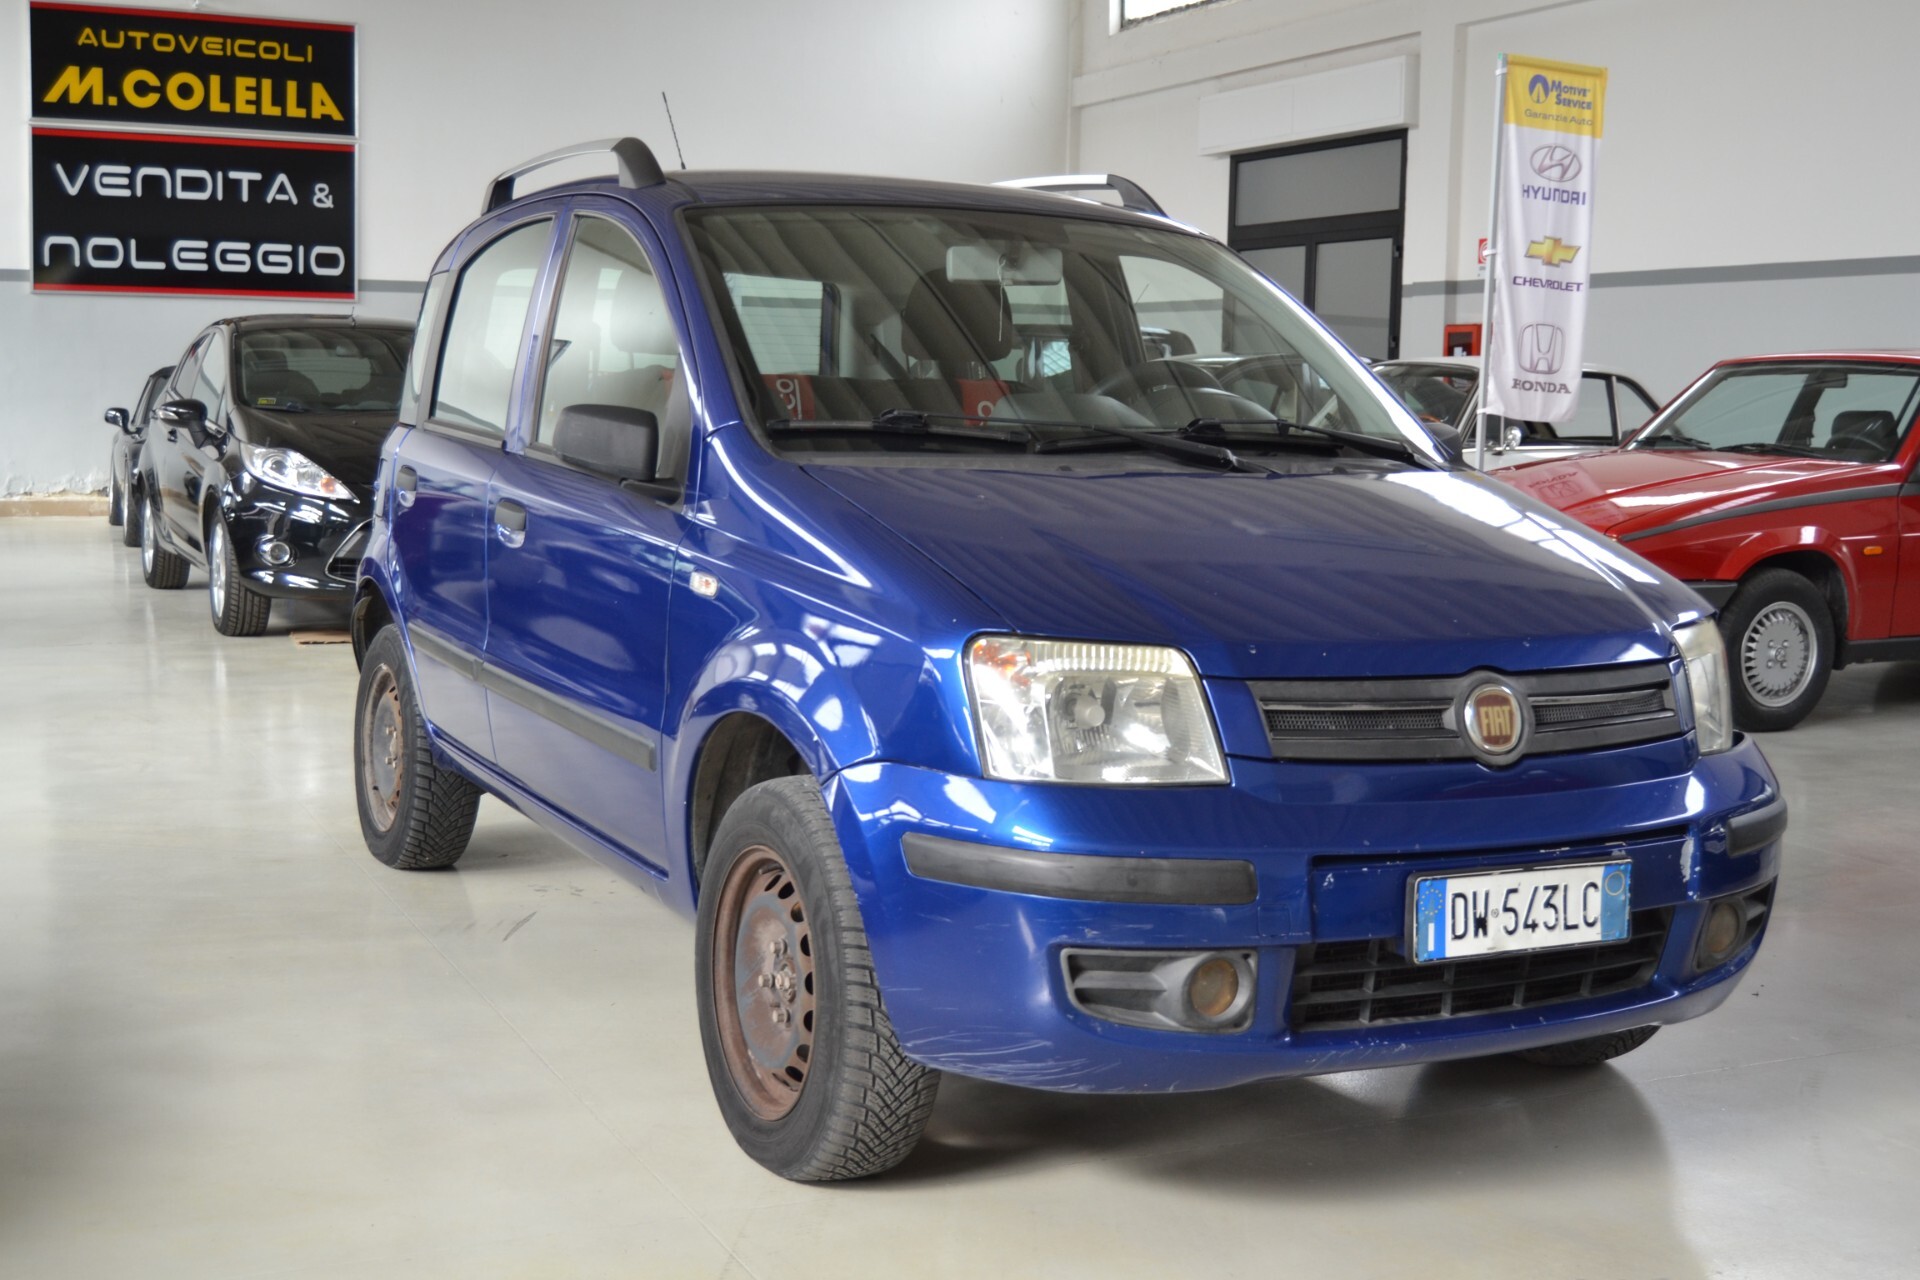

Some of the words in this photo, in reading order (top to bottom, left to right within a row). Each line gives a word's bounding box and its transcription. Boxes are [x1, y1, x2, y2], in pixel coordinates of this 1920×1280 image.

[77, 27, 313, 63] AUTOVEICOLI
[43, 65, 345, 121] M.COLELLA
[1550, 79, 1588, 98] MOTIVE
[1555, 93, 1593, 110] SERVICE
[1524, 108, 1569, 123] Garanzia
[1569, 115, 1593, 126] Auto
[55, 162, 298, 206] VENDITA
[312, 182, 334, 209] &
[1522, 184, 1586, 206] HYUNDAI
[43, 235, 345, 277] NOLEGGIO
[1512, 275, 1583, 292] CHEVROLET
[1511, 378, 1572, 394] HONDA
[1479, 705, 1513, 737] FIAT
